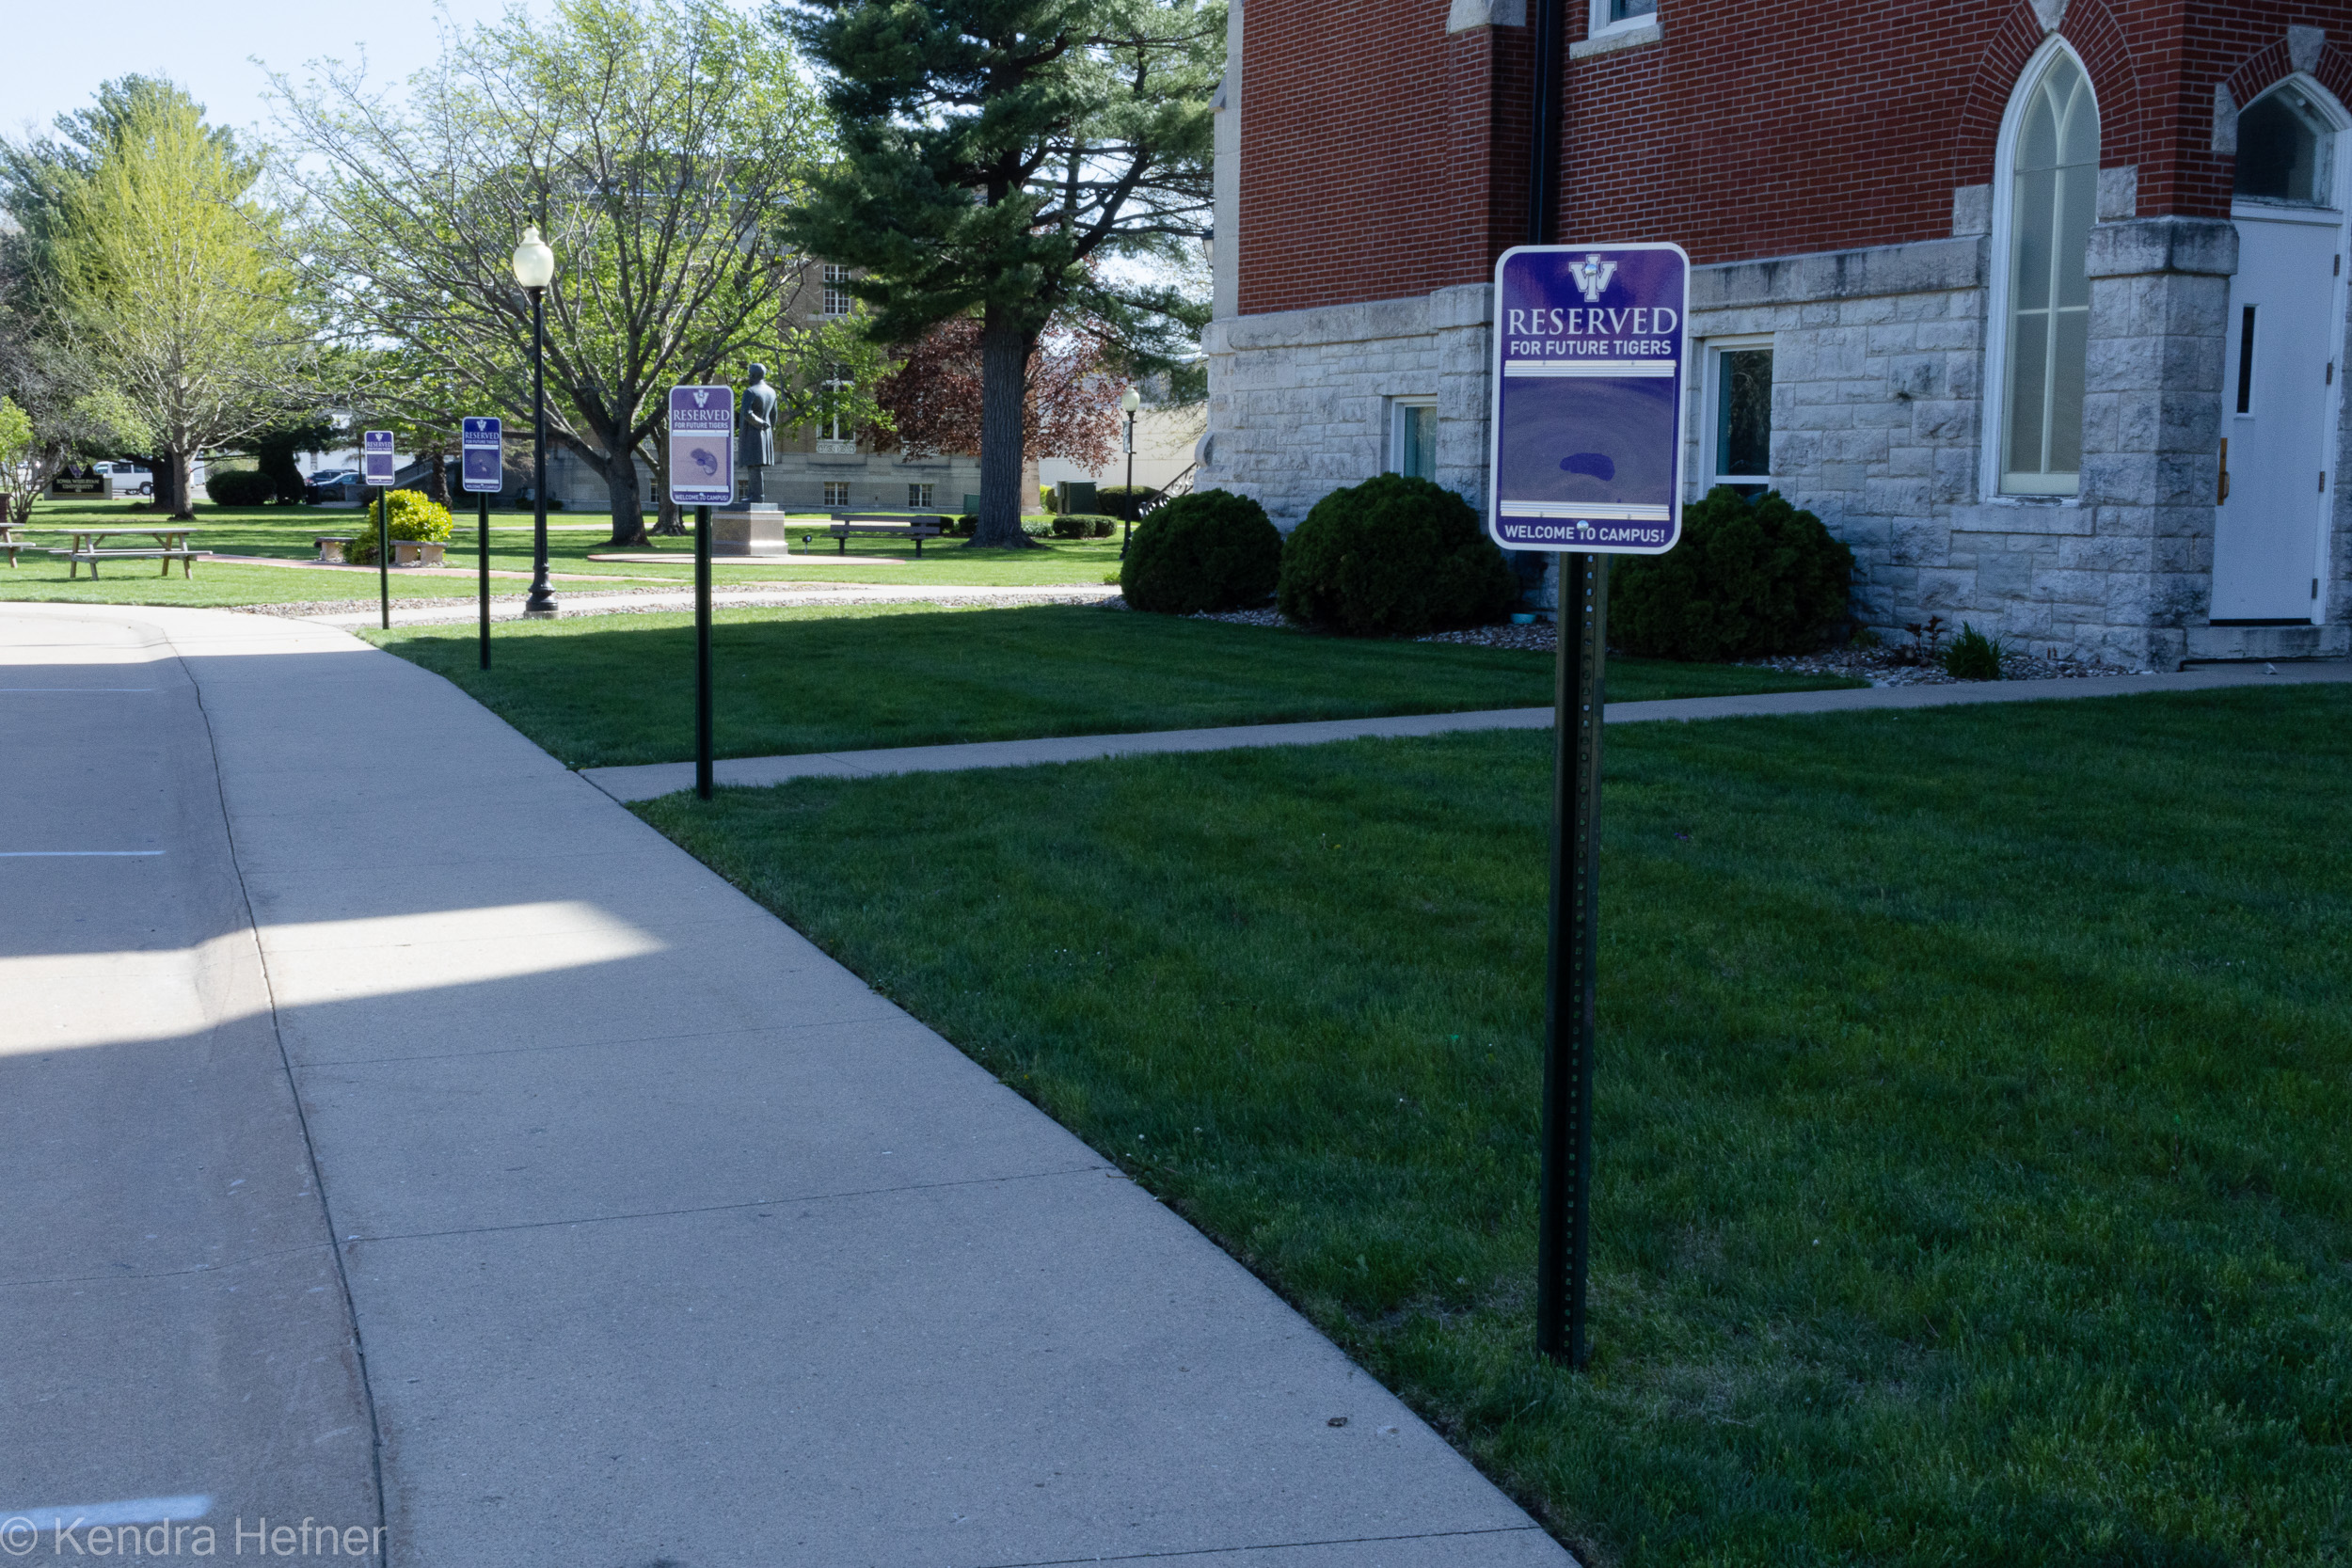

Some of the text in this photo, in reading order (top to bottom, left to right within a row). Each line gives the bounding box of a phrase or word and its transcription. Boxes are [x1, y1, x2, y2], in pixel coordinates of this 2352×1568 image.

[1507, 308, 1677, 335] RESERVED
[1510, 340, 1672, 356] FOR FUTURE TIGERS
[673, 409, 730, 421] RESERVED
[1504, 524, 1575, 540] WELCOME
[1599, 527, 1665, 543] CAMPUS!
